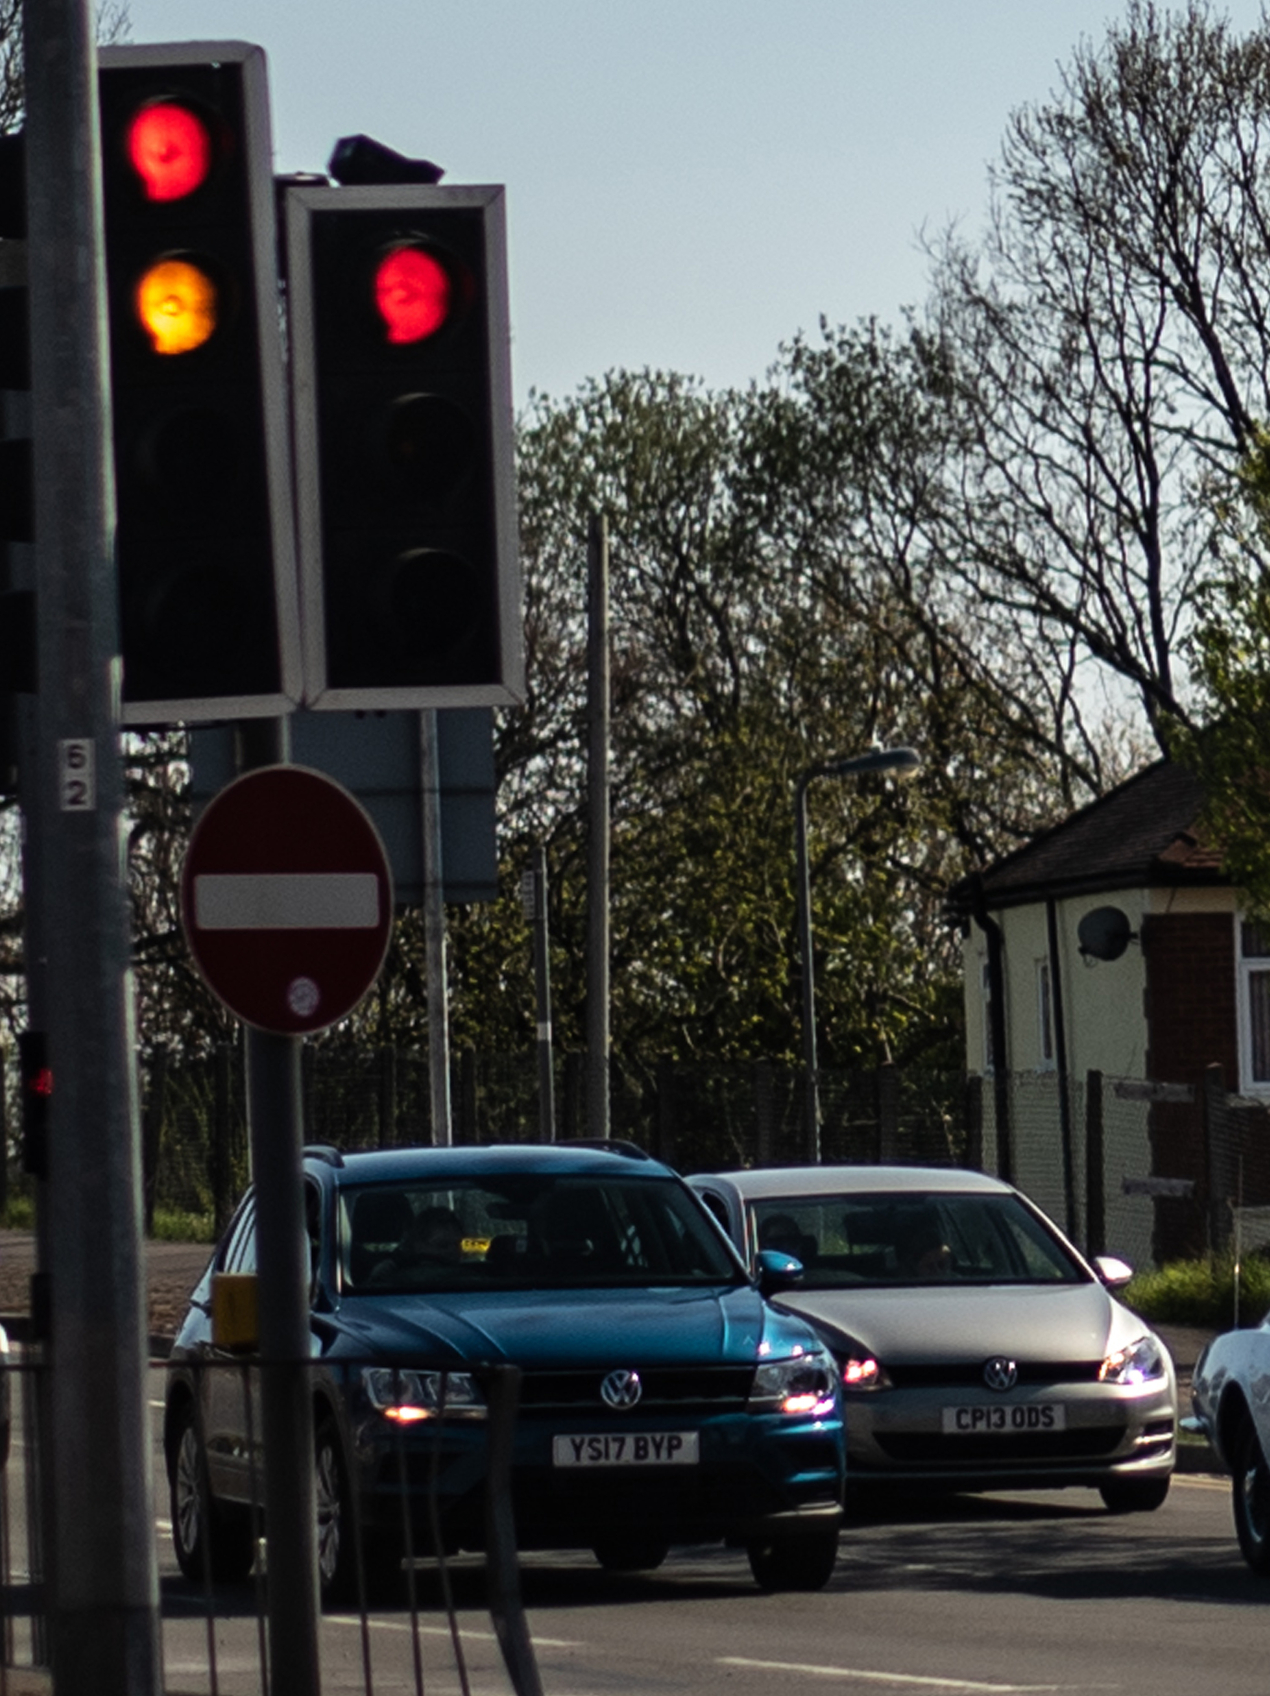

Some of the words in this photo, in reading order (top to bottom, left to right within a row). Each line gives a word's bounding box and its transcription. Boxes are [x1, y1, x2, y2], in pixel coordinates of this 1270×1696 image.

[955, 1407, 1006, 1430] CP13
[1011, 1405, 1055, 1429] ODS
[571, 1436, 626, 1462] YS17
[634, 1435, 683, 1460] BYP
